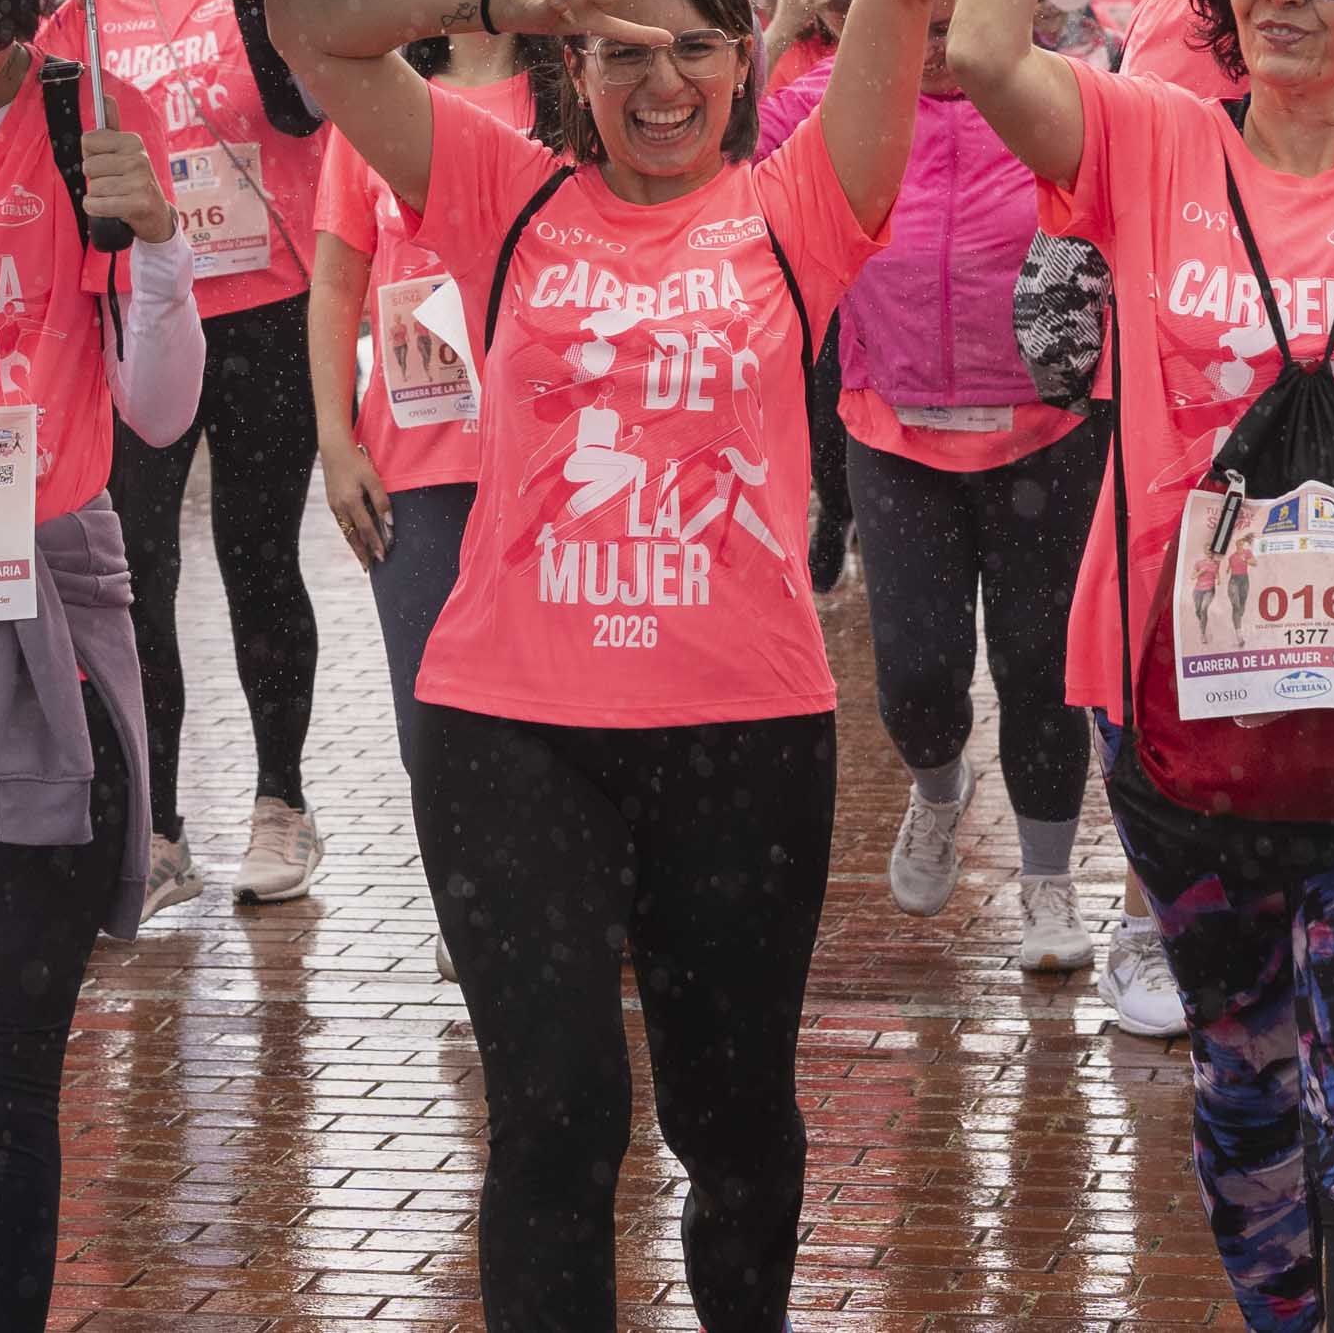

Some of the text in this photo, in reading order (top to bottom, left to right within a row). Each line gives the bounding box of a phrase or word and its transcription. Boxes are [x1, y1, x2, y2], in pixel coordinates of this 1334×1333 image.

[535, 221, 628, 255] OYSHO
[529, 258, 746, 319] CARRERA
[642, 328, 725, 413] DE
[627, 457, 681, 539] LA
[538, 542, 712, 607] MUJER
[592, 613, 659, 649] 2026
[1283, 628, 1329, 646] 1377
[1188, 657, 1240, 674] CARRERA
[1242, 655, 1258, 669] DE
[1260, 654, 1276, 667] LA
[1279, 652, 1322, 666] MUJER
[1205, 688, 1248, 704] OYSHO
[1278, 682, 1328, 694] ASTURIANA
